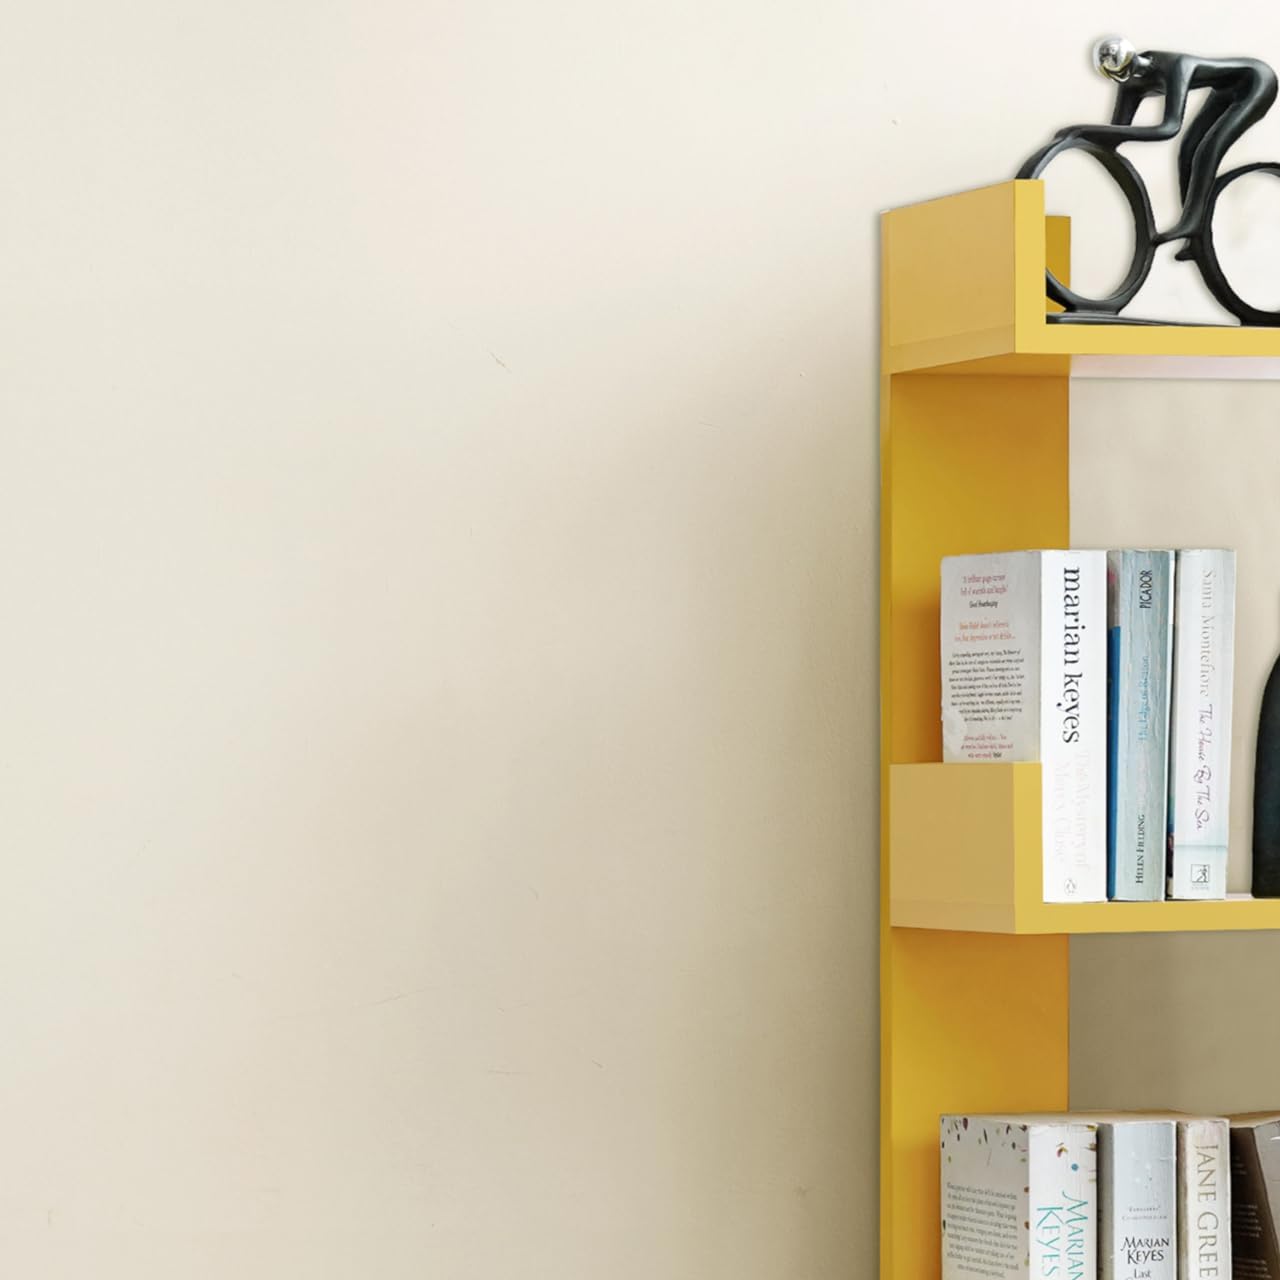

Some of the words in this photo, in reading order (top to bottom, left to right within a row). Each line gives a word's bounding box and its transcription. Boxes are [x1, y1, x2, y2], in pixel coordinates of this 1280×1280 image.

[1139, 570, 1153, 609] PICADOR
[1202, 570, 1217, 608] Santa
[1063, 567, 1086, 665] marian
[1200, 614, 1216, 697] Montefiore
[1056, 672, 1083, 744] keyes
[1198, 703, 1213, 724] The
[1196, 785, 1211, 806] The
[1136, 815, 1146, 852] FIELDING
[1135, 855, 1145, 884] HELEN
[1196, 1145, 1219, 1202] JANE
[1036, 1207, 1064, 1277] KEYES
[1120, 1237, 1170, 1252] MARIAN
[1127, 1249, 1165, 1264] KEYES
[1134, 1269, 1152, 1279] Last
